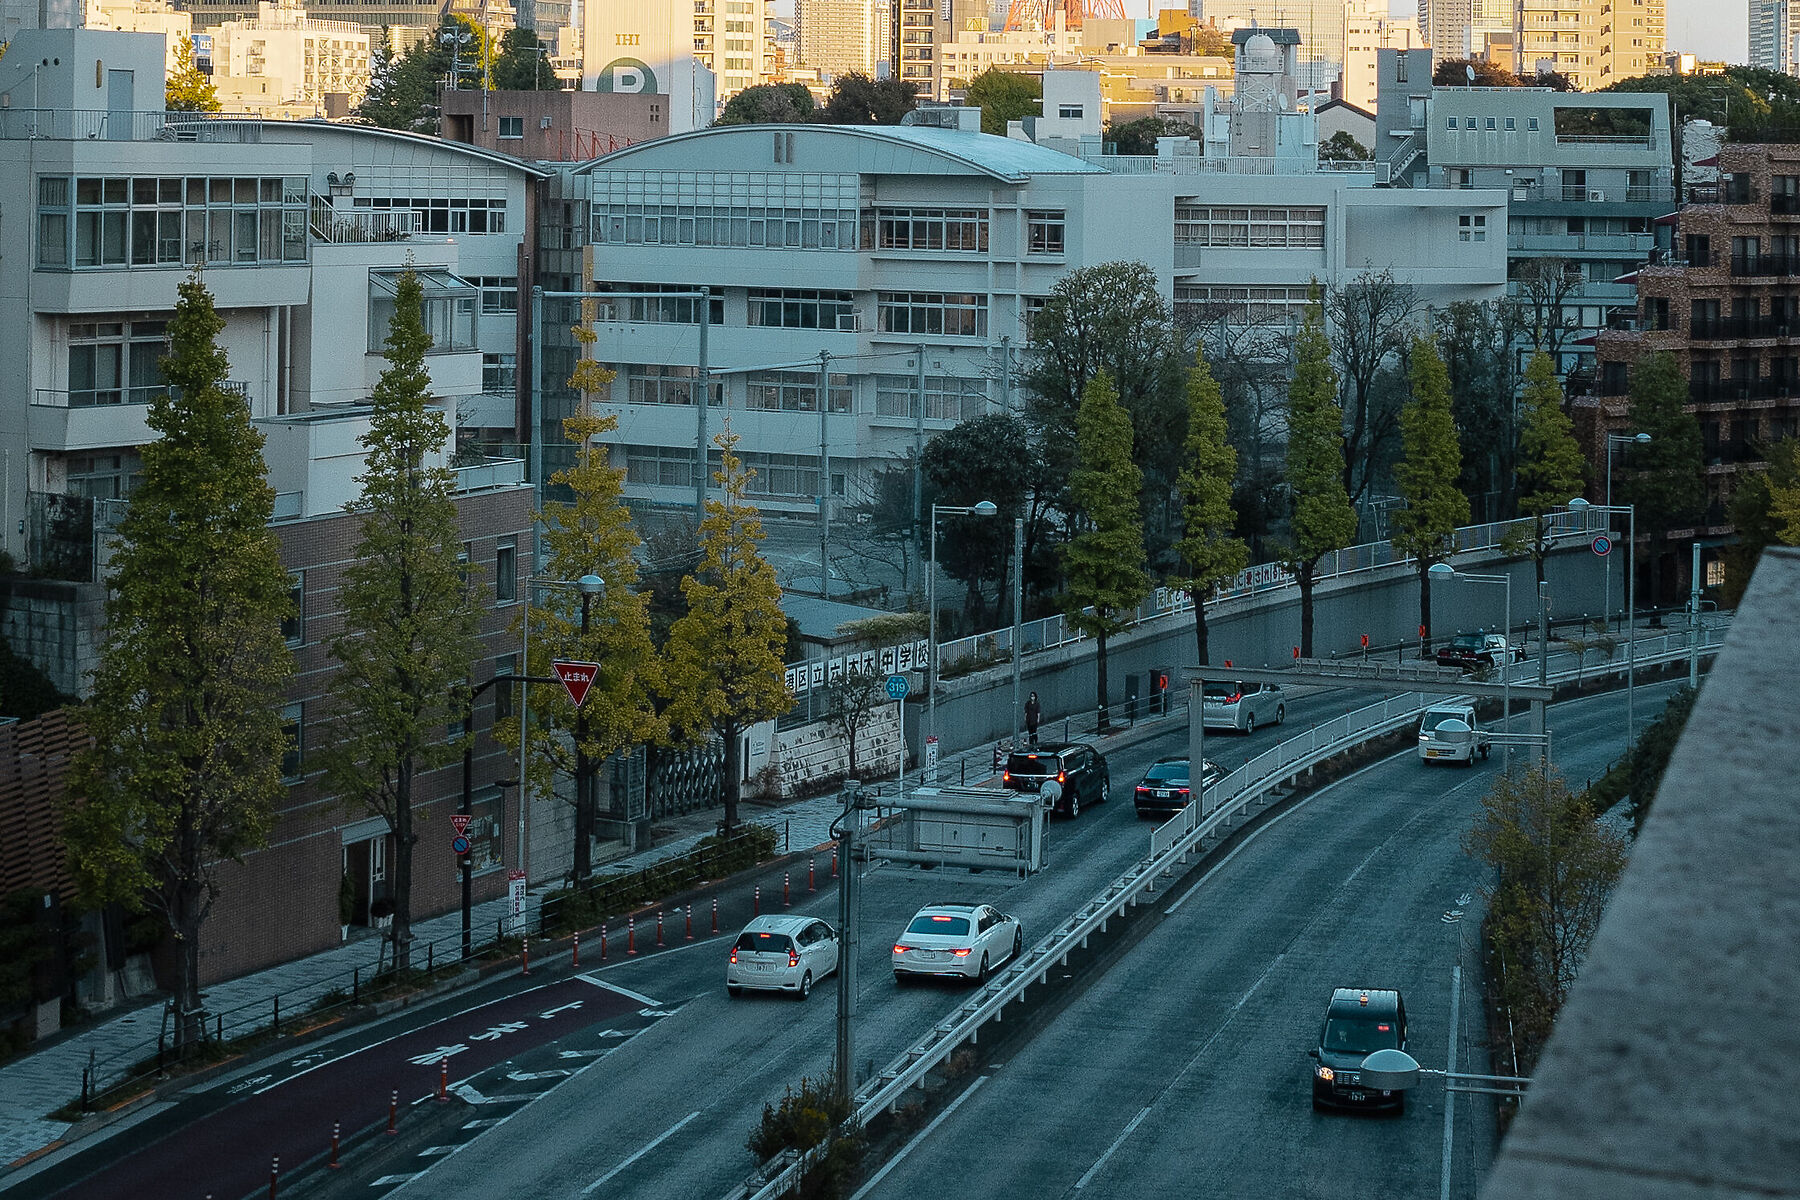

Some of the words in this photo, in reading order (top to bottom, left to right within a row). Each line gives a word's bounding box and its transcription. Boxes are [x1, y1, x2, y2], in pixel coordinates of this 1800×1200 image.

[615, 33, 640, 46] IHI
[563, 671, 590, 682] 止まれ
[889, 682, 905, 691] 319
